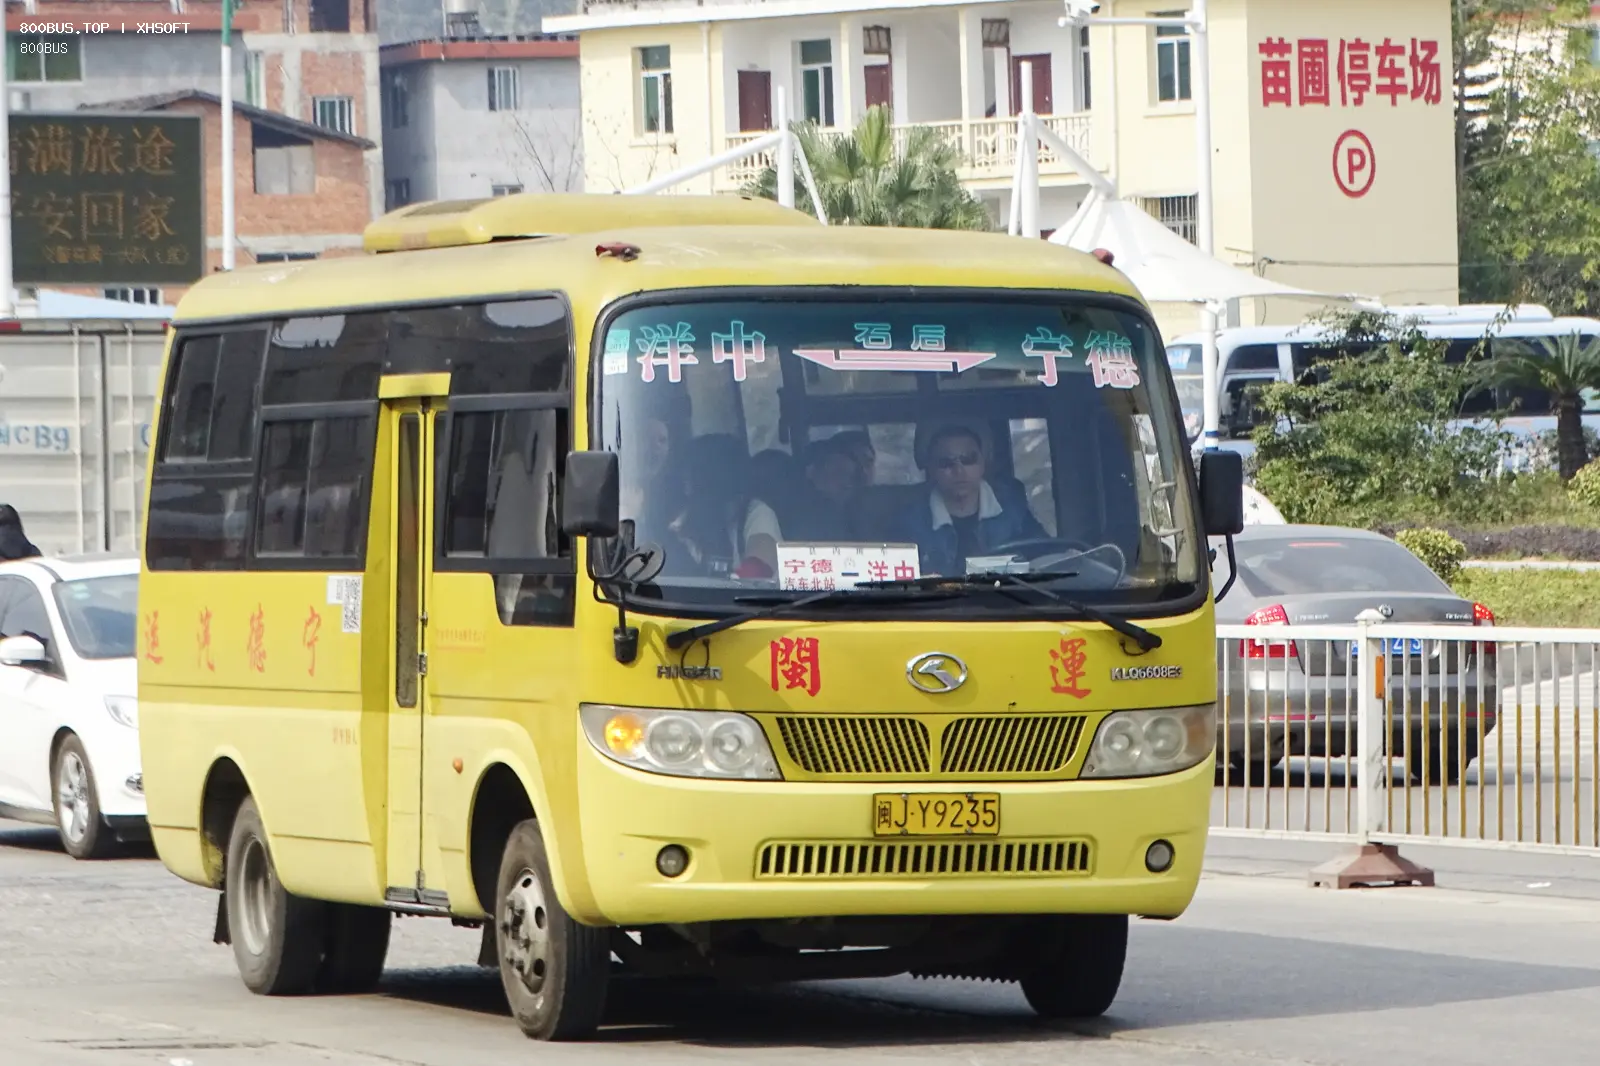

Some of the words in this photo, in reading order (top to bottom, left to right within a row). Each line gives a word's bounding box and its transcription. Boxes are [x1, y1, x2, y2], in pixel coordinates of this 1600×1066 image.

[1258, 37, 1441, 107] 苗圃停车场
[1347, 148, 1366, 184] P
[636, 321, 765, 383] 洋中
[854, 323, 945, 350] 石后
[1021, 327, 1140, 389] 宁德
[784, 558, 833, 574] 宁德
[1049, 638, 1092, 699] 運
